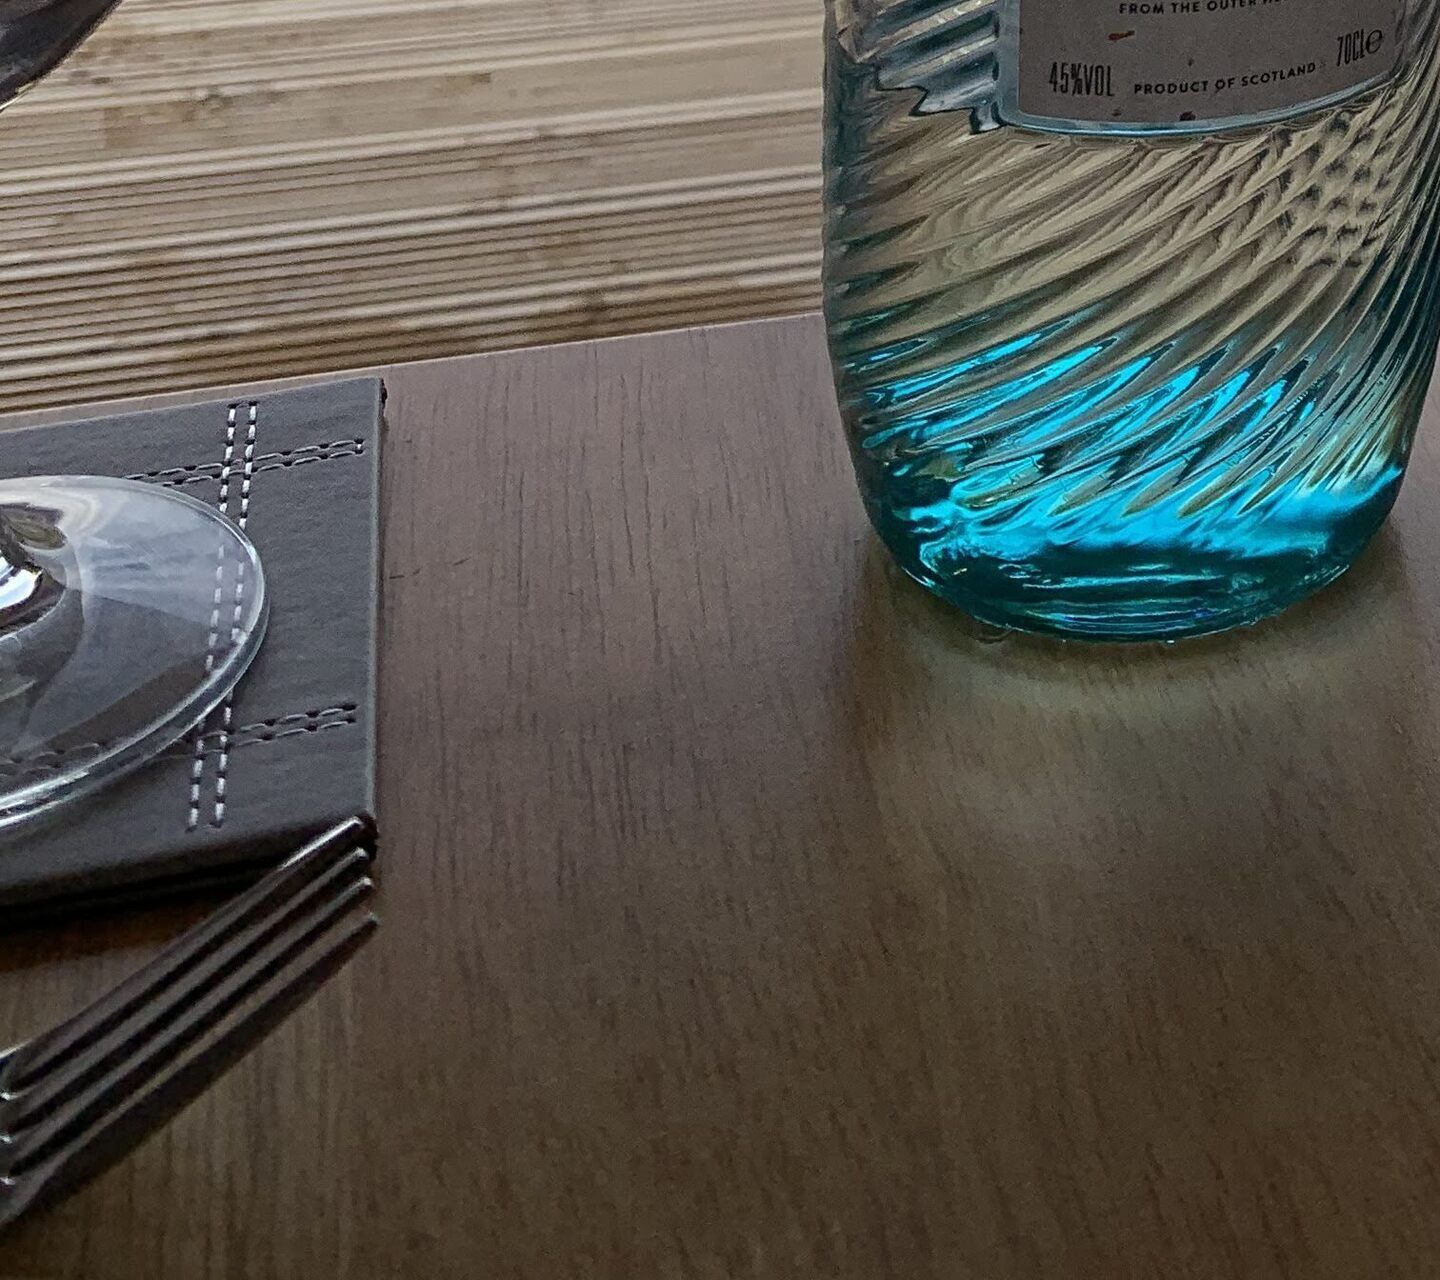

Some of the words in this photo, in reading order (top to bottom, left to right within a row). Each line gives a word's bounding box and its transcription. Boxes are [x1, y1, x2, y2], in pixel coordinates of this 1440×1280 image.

[1119, 2, 1164, 15] FROM
[1171, 2, 1200, 13] THE
[1134, 79, 1209, 95] PRODUCT
[1215, 77, 1236, 91] OF
[1241, 62, 1317, 88] SCOTLAND
